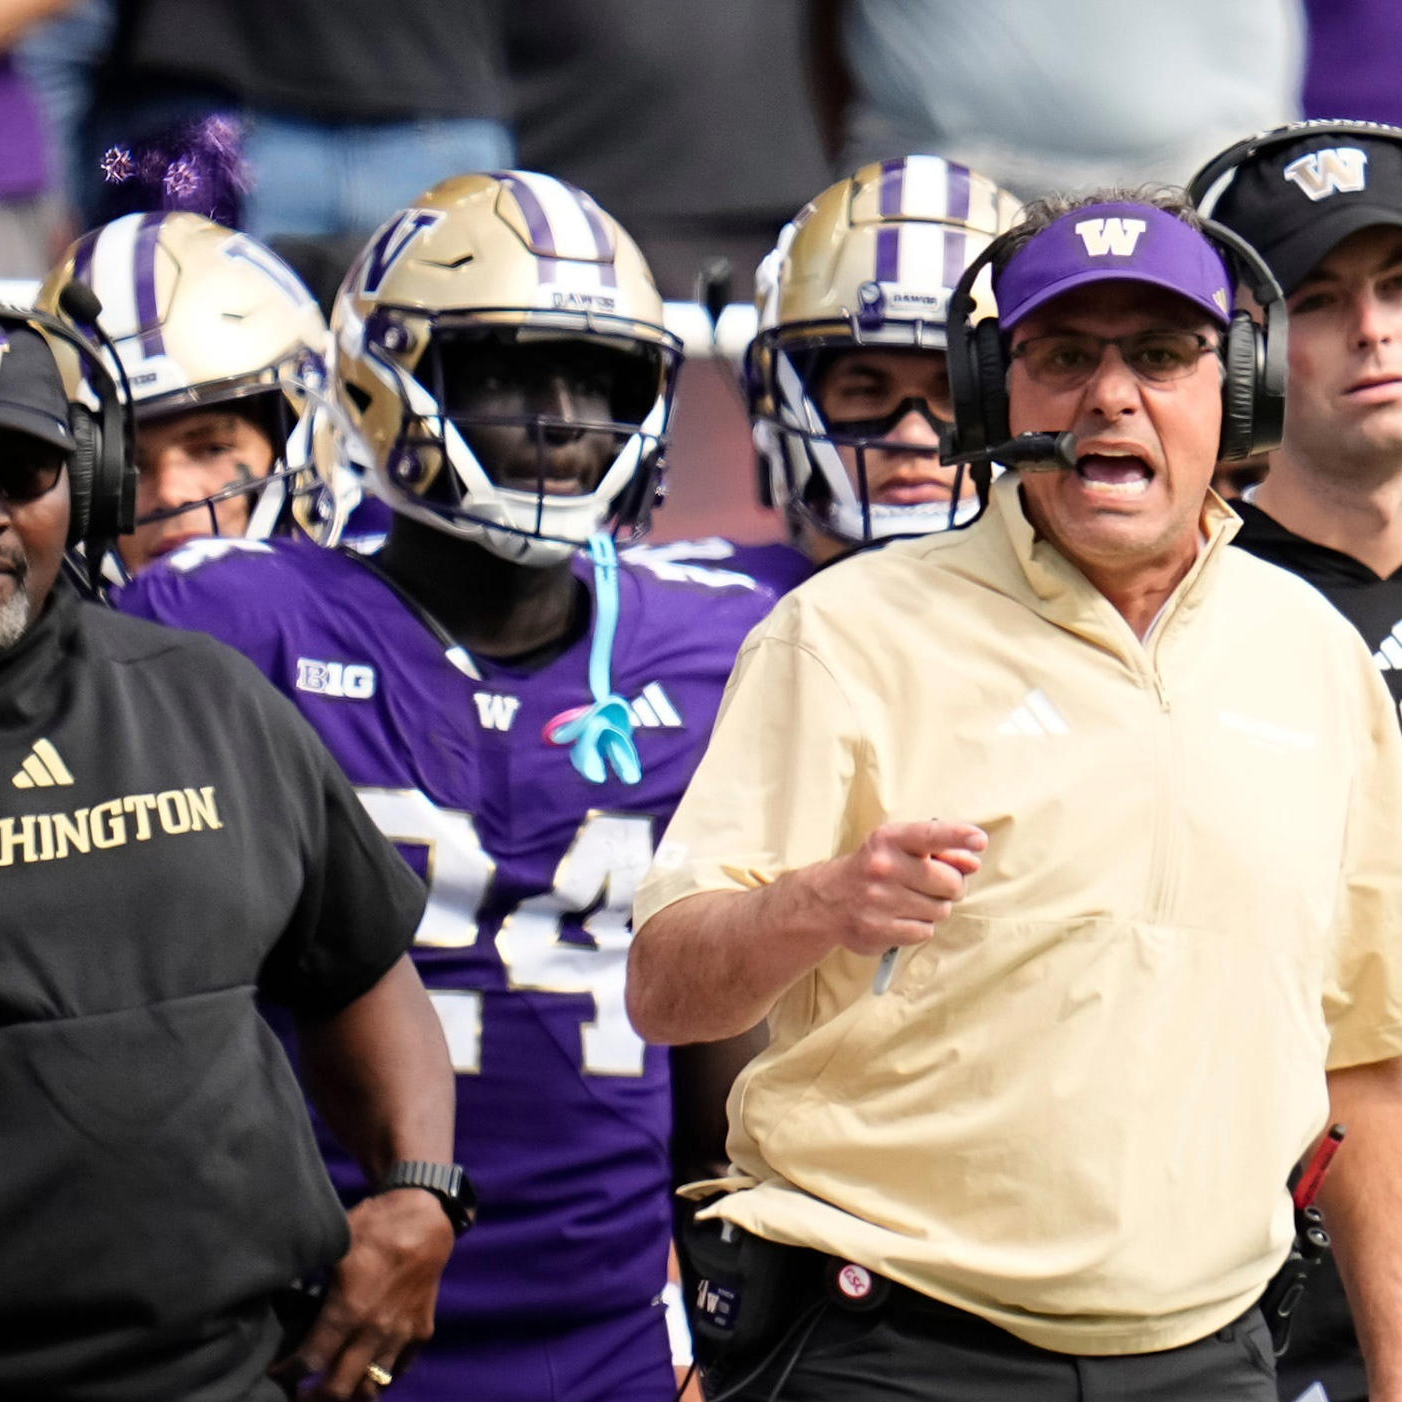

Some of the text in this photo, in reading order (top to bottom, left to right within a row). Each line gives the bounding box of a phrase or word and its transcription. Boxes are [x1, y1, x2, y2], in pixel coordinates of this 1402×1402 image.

[1284, 147, 1368, 201] W
[1075, 217, 1146, 257] W
[473, 692, 521, 732] W
